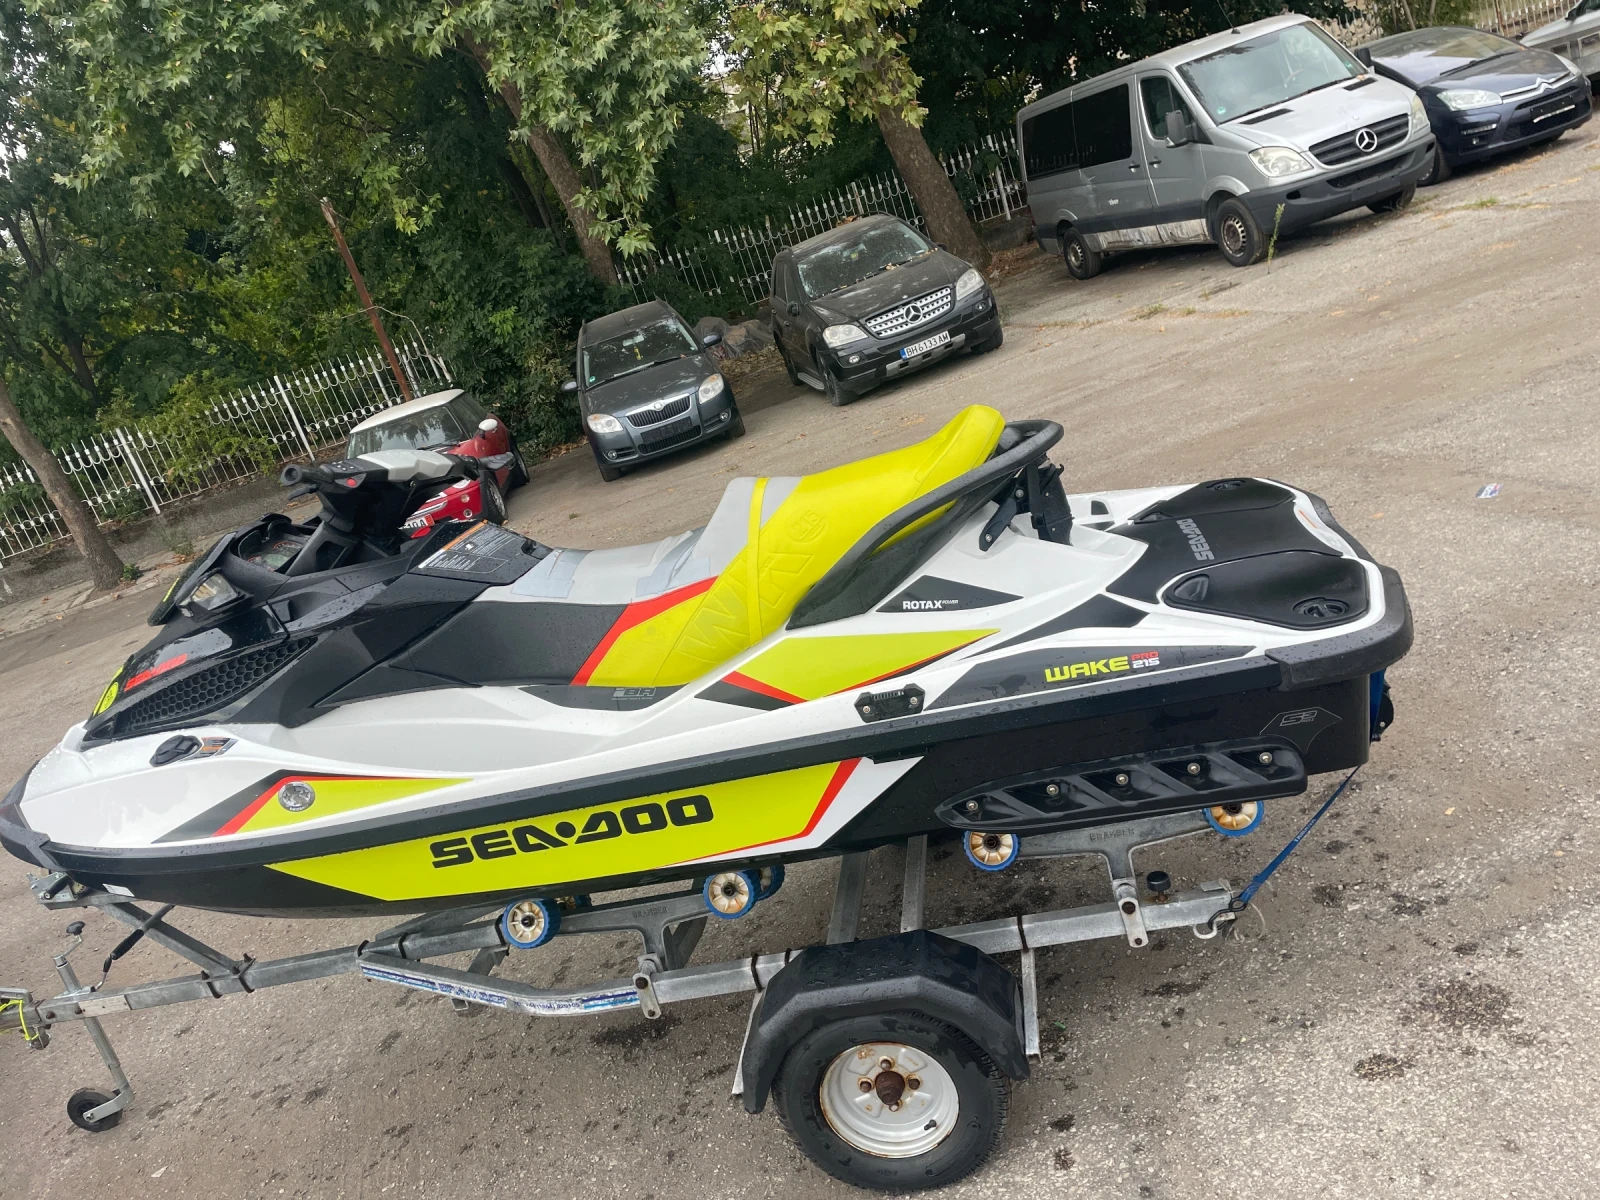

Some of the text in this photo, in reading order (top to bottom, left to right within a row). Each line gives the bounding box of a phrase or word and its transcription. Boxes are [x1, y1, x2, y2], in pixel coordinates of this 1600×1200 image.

[902, 600, 942, 610] ROTAX
[1044, 651, 1159, 682] WAKE PRO
[1132, 657, 1160, 669] 215
